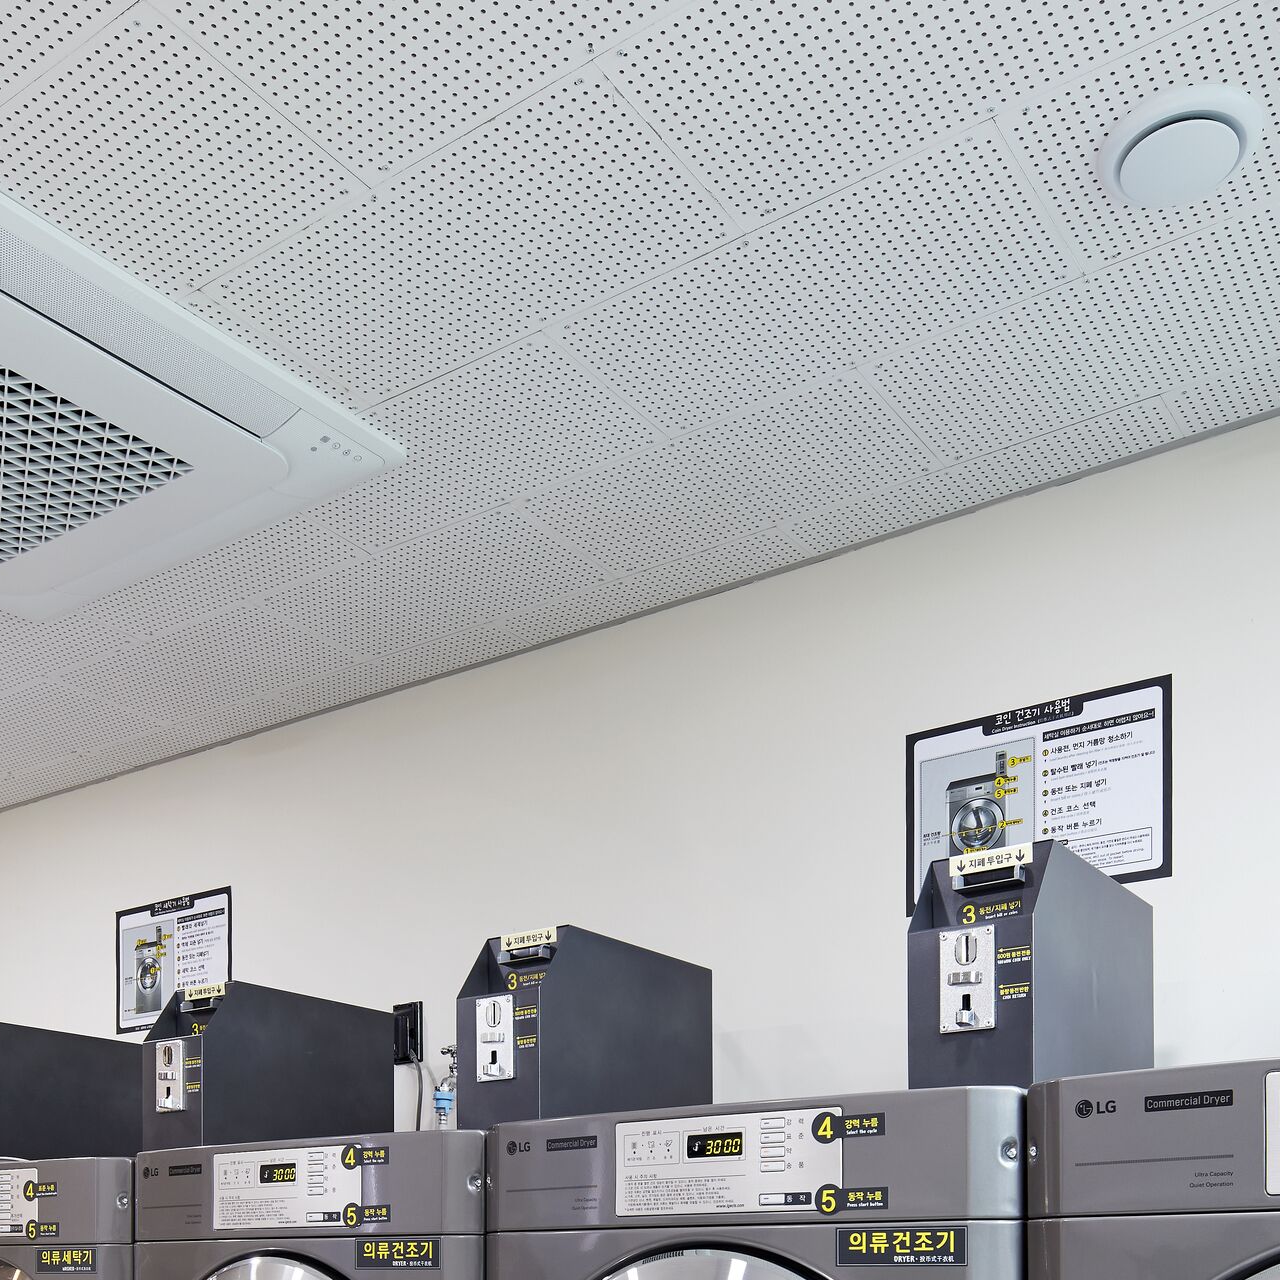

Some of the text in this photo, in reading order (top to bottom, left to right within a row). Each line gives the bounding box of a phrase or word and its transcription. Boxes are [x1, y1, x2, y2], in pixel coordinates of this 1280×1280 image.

[995, 698, 1070, 726] 코인 건조기 사용법
[962, 904, 976, 924] 3
[508, 973, 517, 990] 3
[192, 1023, 199, 1035] 3
[1096, 1100, 1117, 1114] LG
[1146, 1093, 1230, 1109] Commercial Dryer
[817, 1116, 834, 1139] 4
[519, 1142, 531, 1152] LG
[547, 1138, 596, 1149] Commercial Dryer
[345, 1148, 355, 1166] 4
[1209, 1170, 1233, 1179] Capacity
[26, 1185, 35, 1198] 4
[1203, 1181, 1234, 1189] Operation
[821, 1189, 836, 1212] 5
[347, 1207, 357, 1225] 5
[28, 1223, 36, 1238] 5
[849, 1230, 955, 1254] 의류건조기
[41, 1250, 93, 1265] 의류세탁기
[363, 1241, 433, 1260] 의류건조기
[893, 1255, 915, 1263] DRYER
